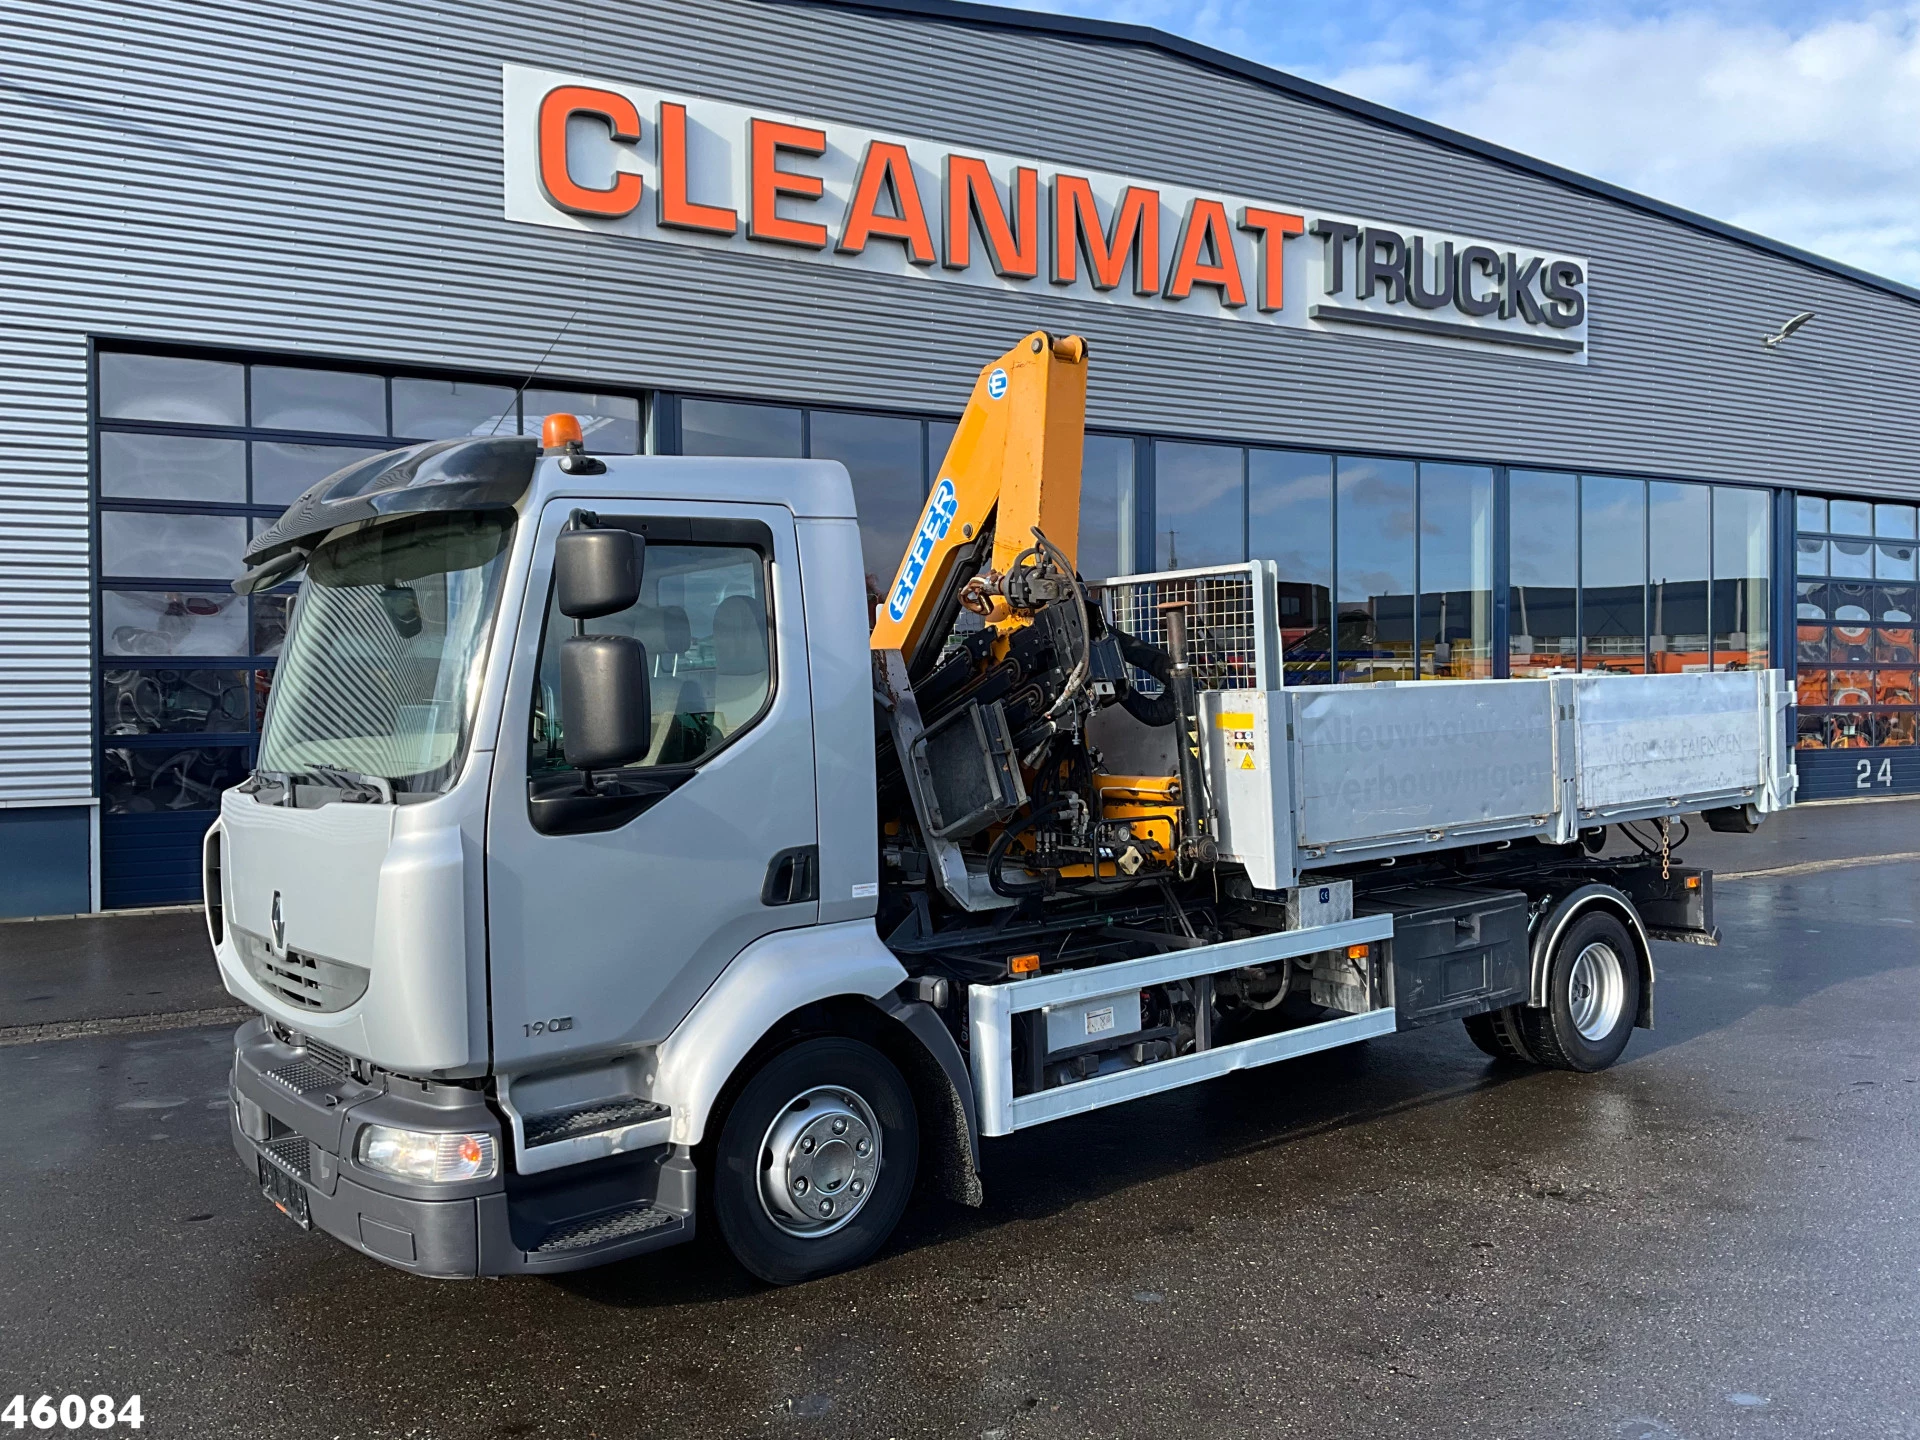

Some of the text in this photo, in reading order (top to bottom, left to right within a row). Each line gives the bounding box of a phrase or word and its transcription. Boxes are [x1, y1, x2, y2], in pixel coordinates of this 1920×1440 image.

[537, 84, 1584, 328] CLEANMAT TRUCKS
[892, 484, 954, 614] EFFER
[1856, 758, 1893, 788] 24
[523, 1018, 560, 1037] 190
